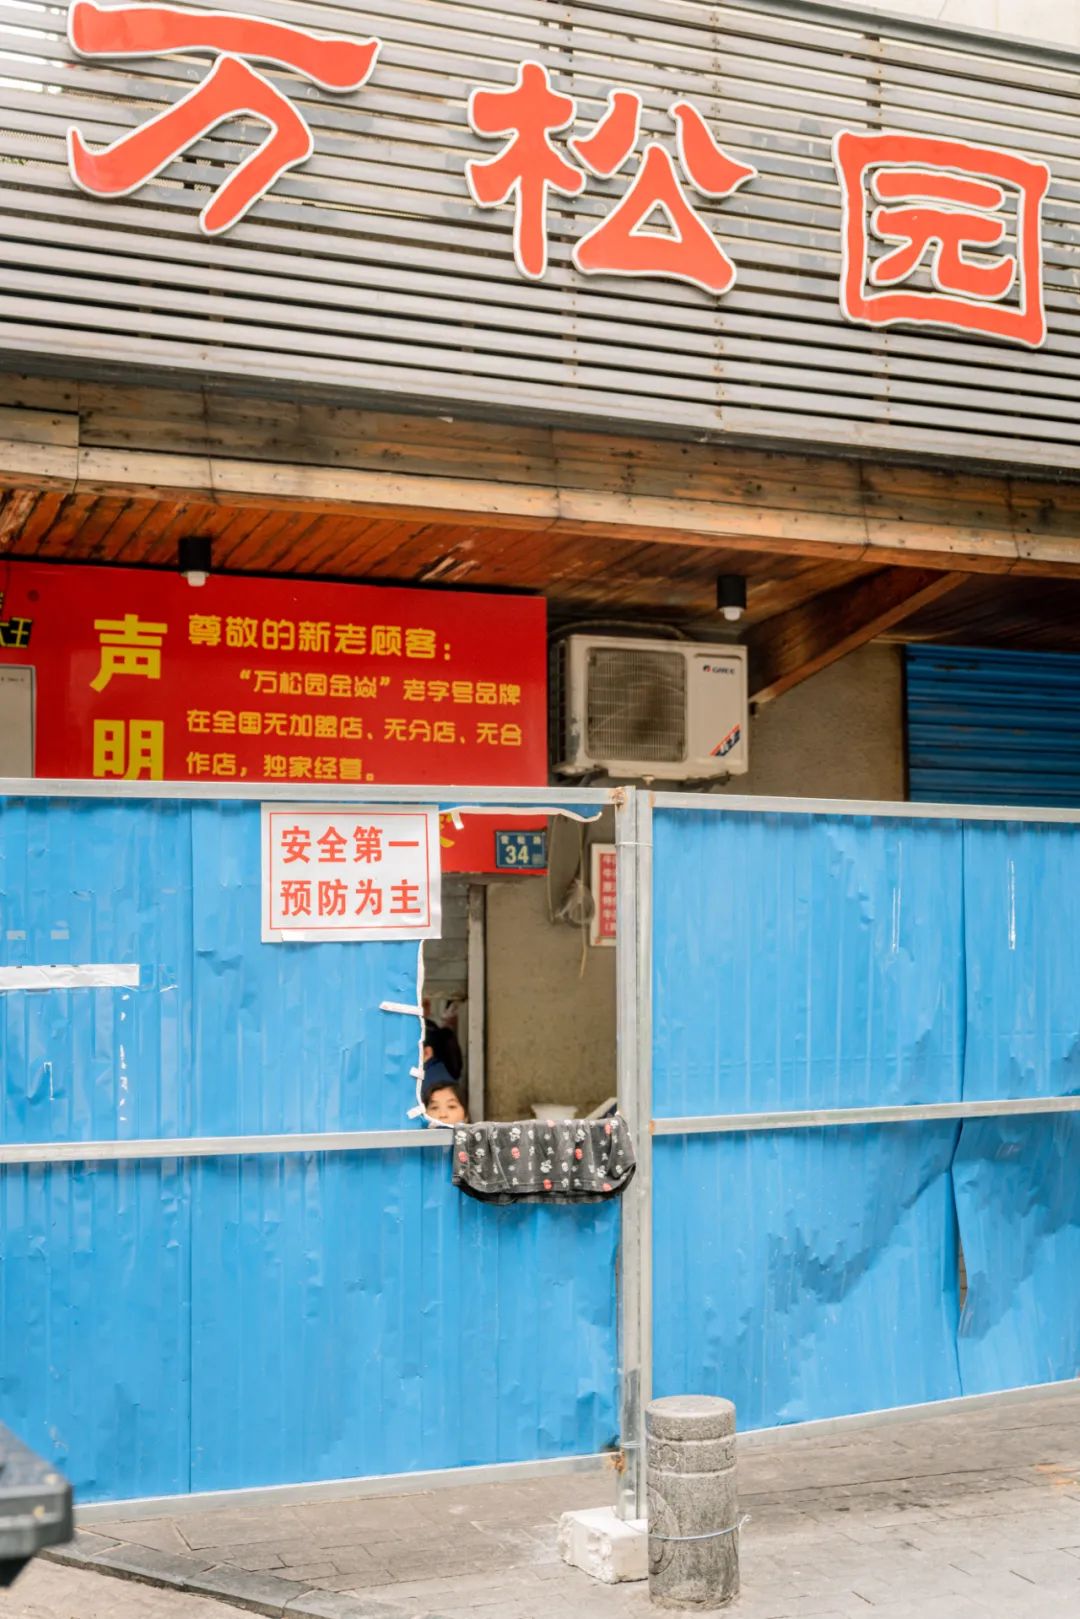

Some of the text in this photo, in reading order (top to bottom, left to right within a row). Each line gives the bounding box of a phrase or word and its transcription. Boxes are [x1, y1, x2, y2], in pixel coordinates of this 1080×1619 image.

[67, 0, 1051, 349] 万松园
[90, 613, 168, 781] 声明
[281, 825, 420, 864] 安全第一
[505, 845, 529, 864] 34
[280, 878, 421, 916] 预防为主
